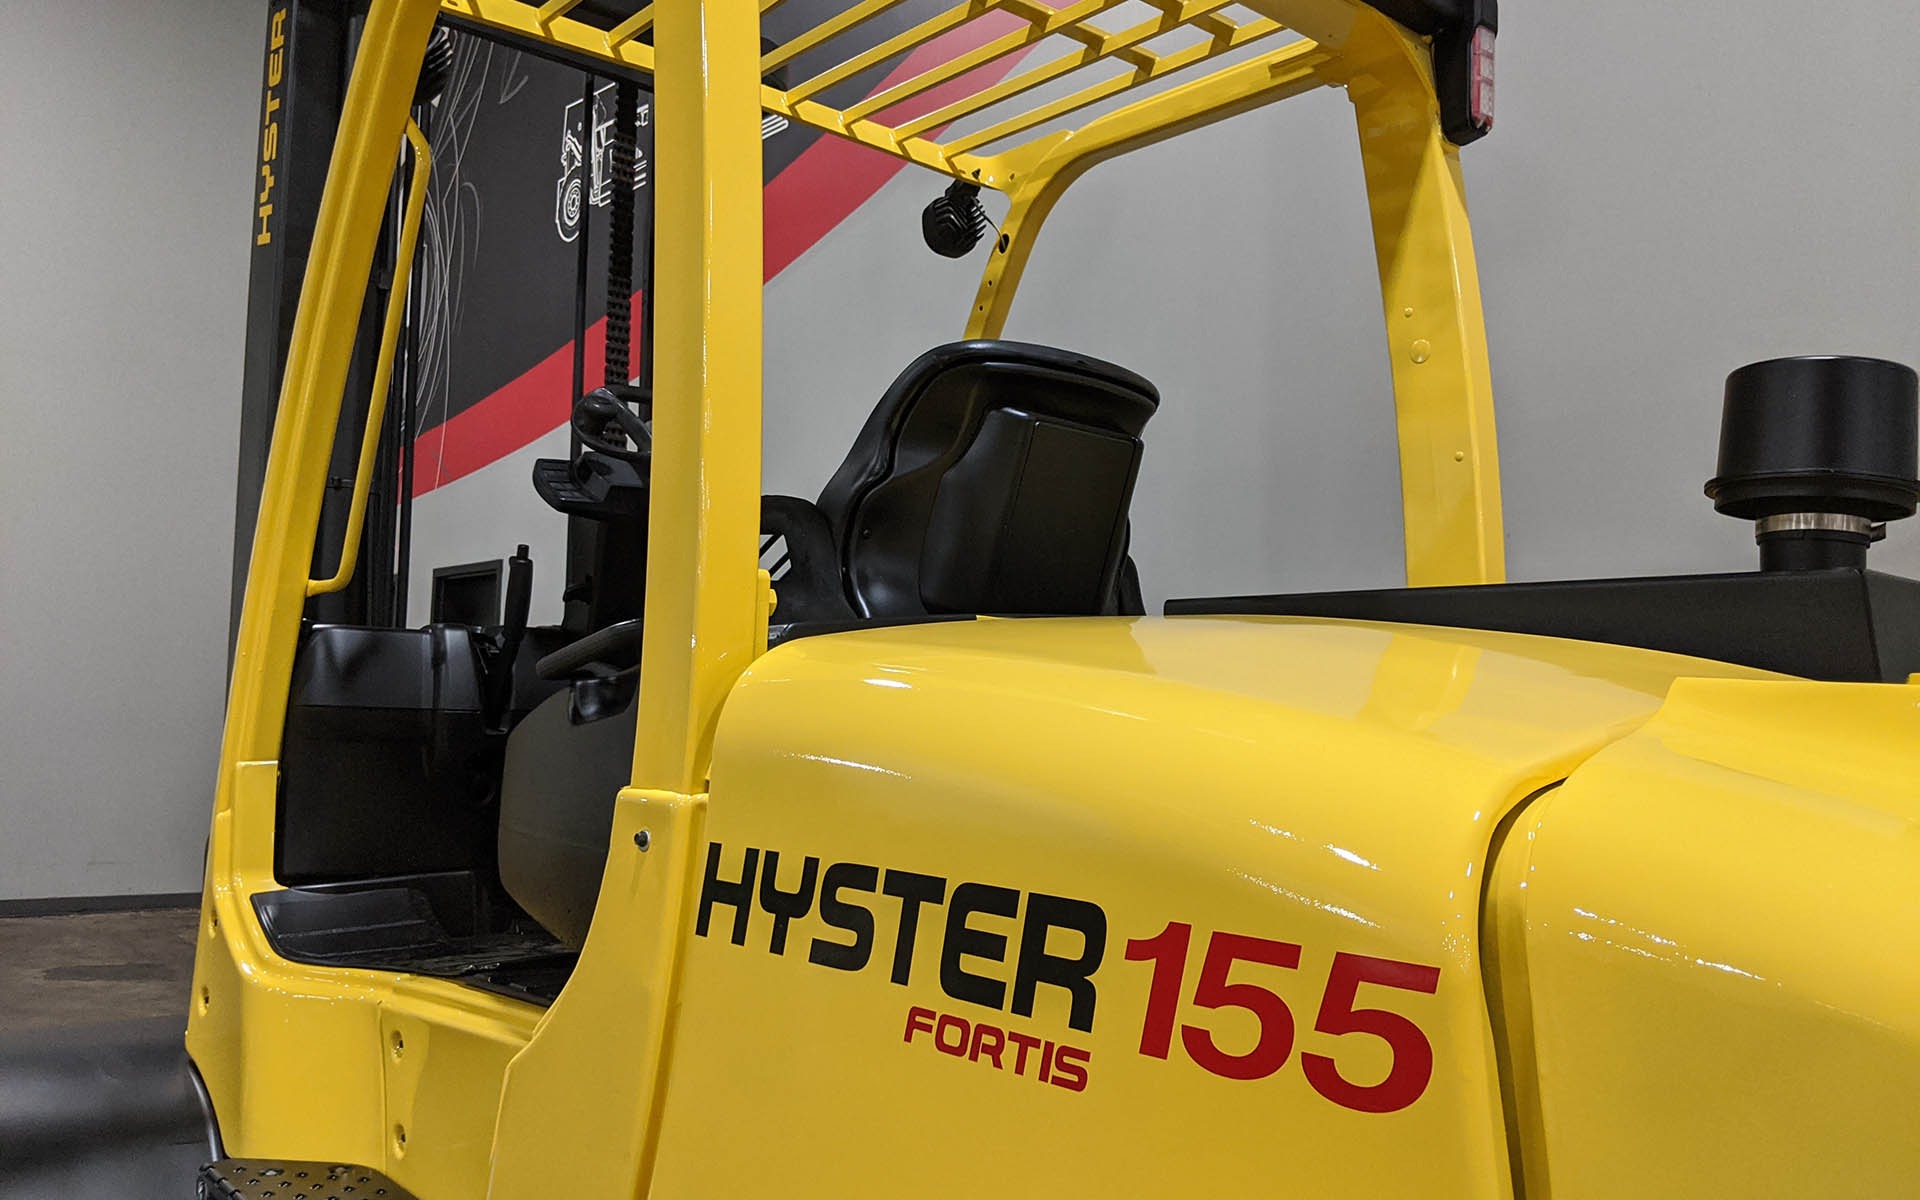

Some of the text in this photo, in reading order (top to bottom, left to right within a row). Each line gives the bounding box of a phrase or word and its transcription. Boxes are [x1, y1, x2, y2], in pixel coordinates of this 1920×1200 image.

[257, 7, 287, 246] HYSTER
[695, 841, 1441, 1114] HYSTER 155
[904, 1006, 1091, 1092] FORTIS
